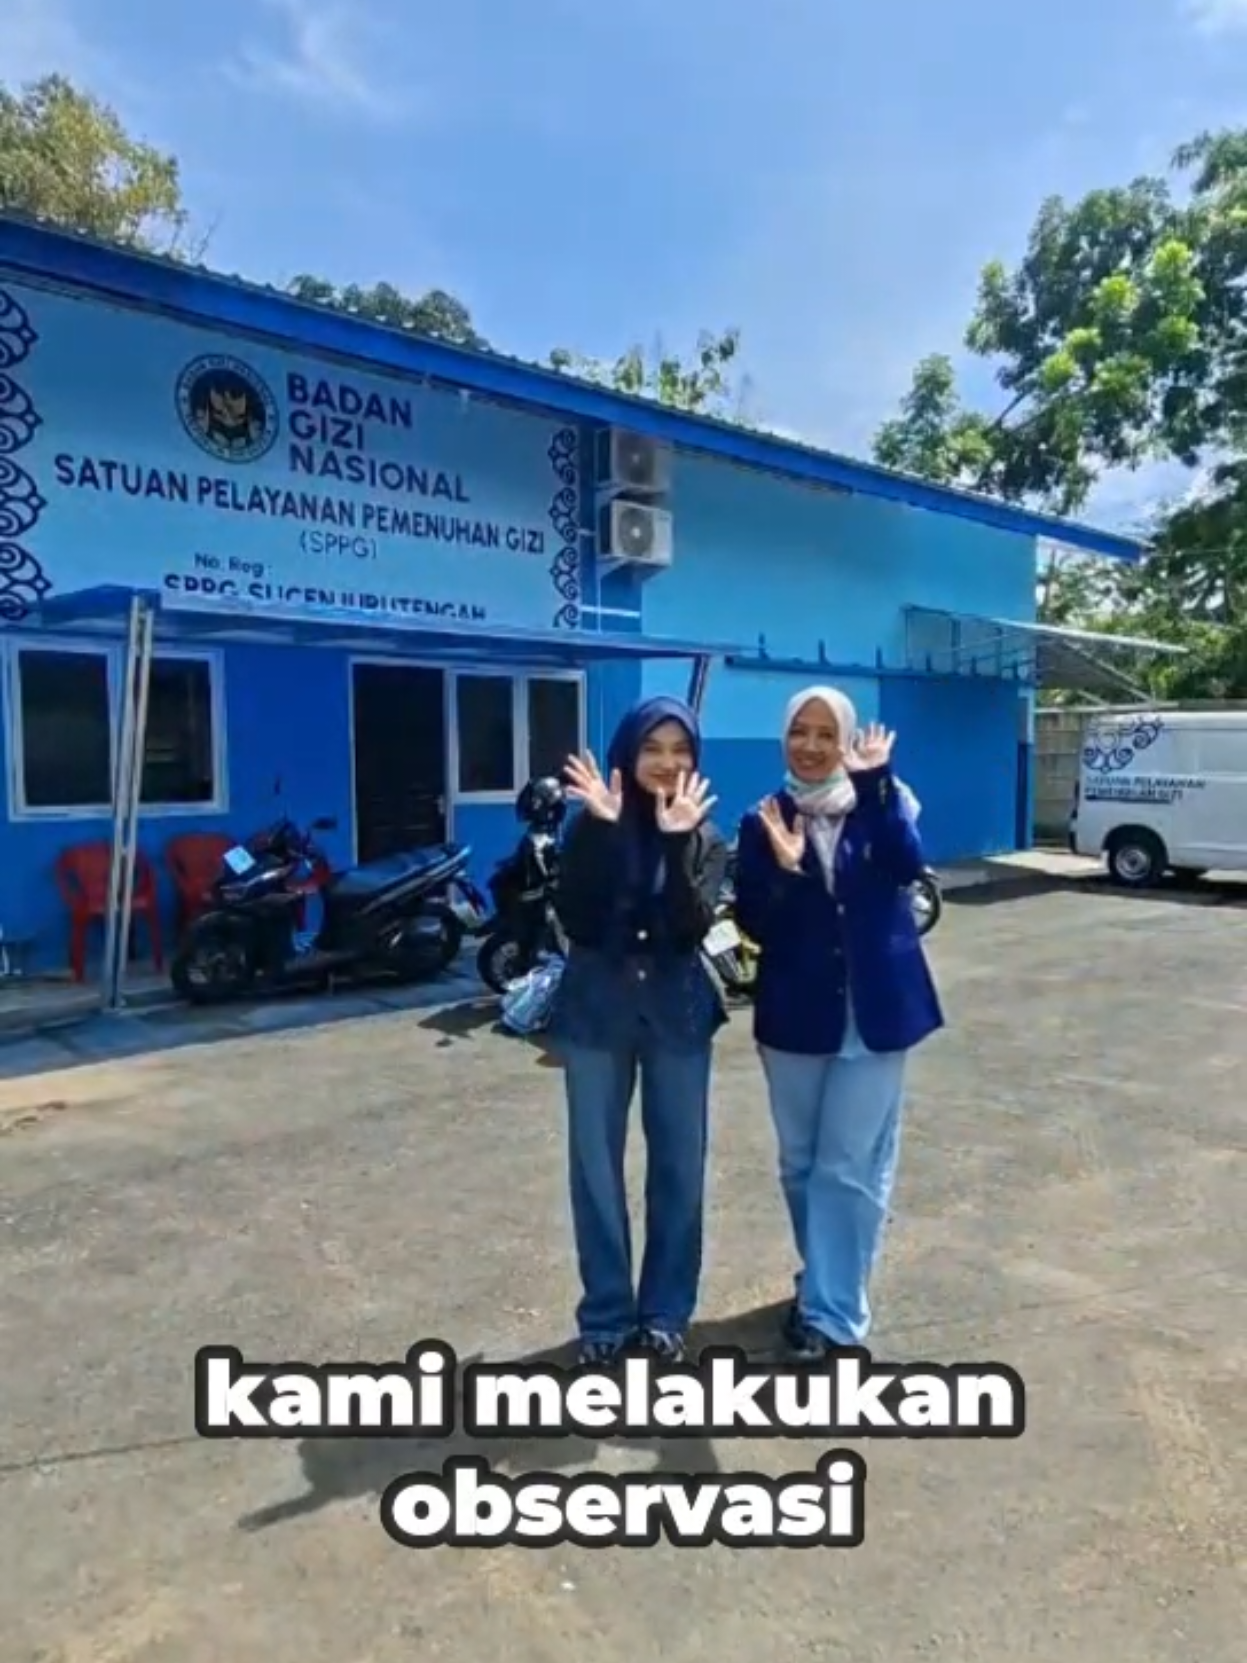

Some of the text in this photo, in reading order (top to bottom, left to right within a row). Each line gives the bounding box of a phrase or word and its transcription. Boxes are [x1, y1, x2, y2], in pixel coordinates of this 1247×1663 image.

[287, 372, 412, 428] BADAN
[289, 410, 364, 450] GIZI
[289, 446, 470, 502] NASIONAL
[54, 454, 544, 554] SATUAN PELAYANAN PEMENUHAN GIZI
[300, 530, 376, 559] (SPPG)
